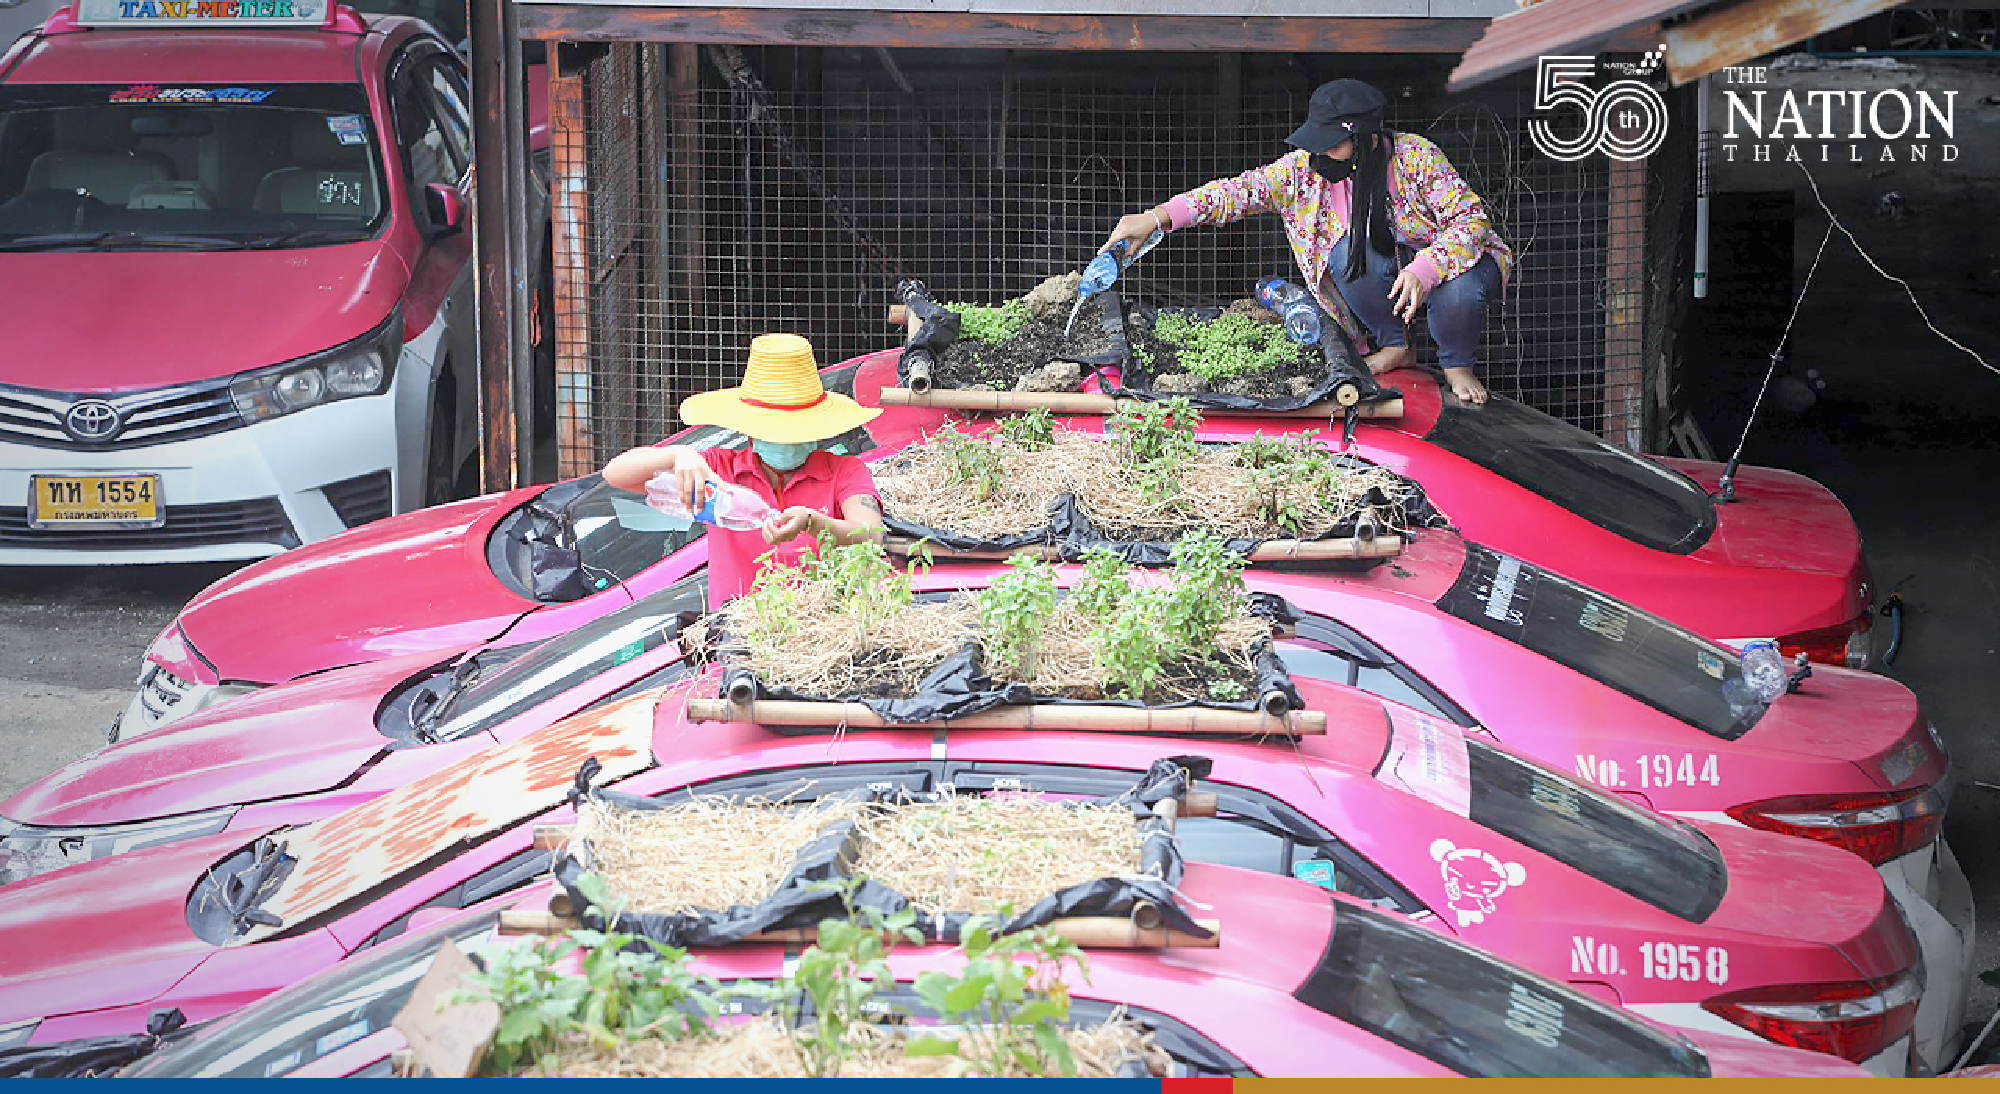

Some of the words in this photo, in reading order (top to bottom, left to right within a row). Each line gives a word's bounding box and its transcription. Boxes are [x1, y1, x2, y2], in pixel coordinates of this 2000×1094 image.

[119, 1, 295, 18] TAXI-METER
[97, 480, 152, 503] 1554
[1575, 754, 1628, 788] No.
[1635, 752, 1721, 789] 1944
[1571, 935, 1628, 975] No.
[1638, 940, 1729, 986] 1958
